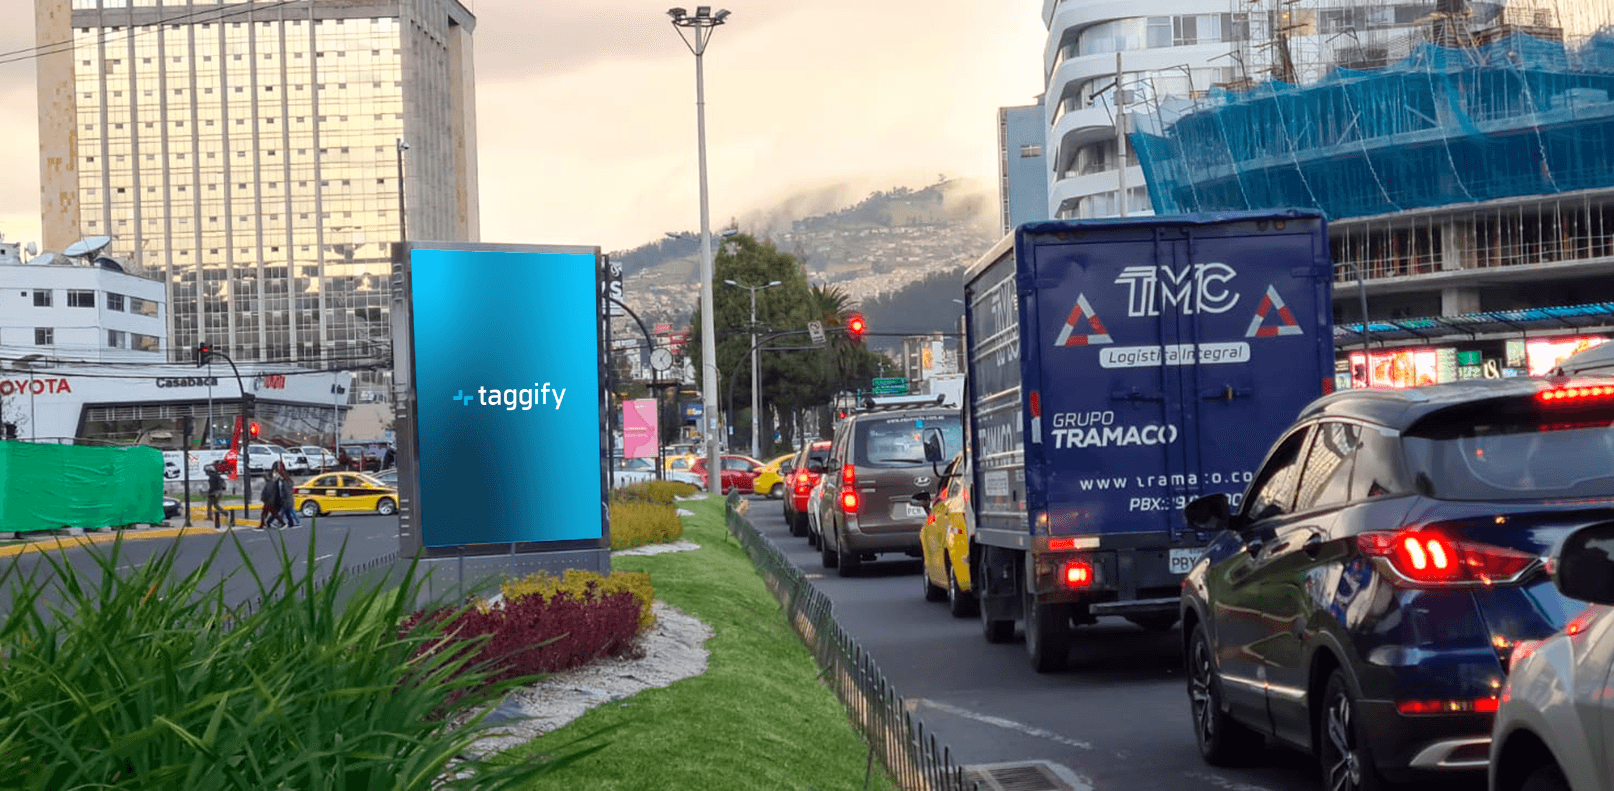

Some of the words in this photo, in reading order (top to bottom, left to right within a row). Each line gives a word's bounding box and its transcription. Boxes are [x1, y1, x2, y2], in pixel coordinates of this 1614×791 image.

[1114, 262, 1240, 317] TMC
[478, 382, 567, 411] taggify
[1053, 411, 1114, 428] GRUPO
[1051, 424, 1178, 449] TRAMACO
